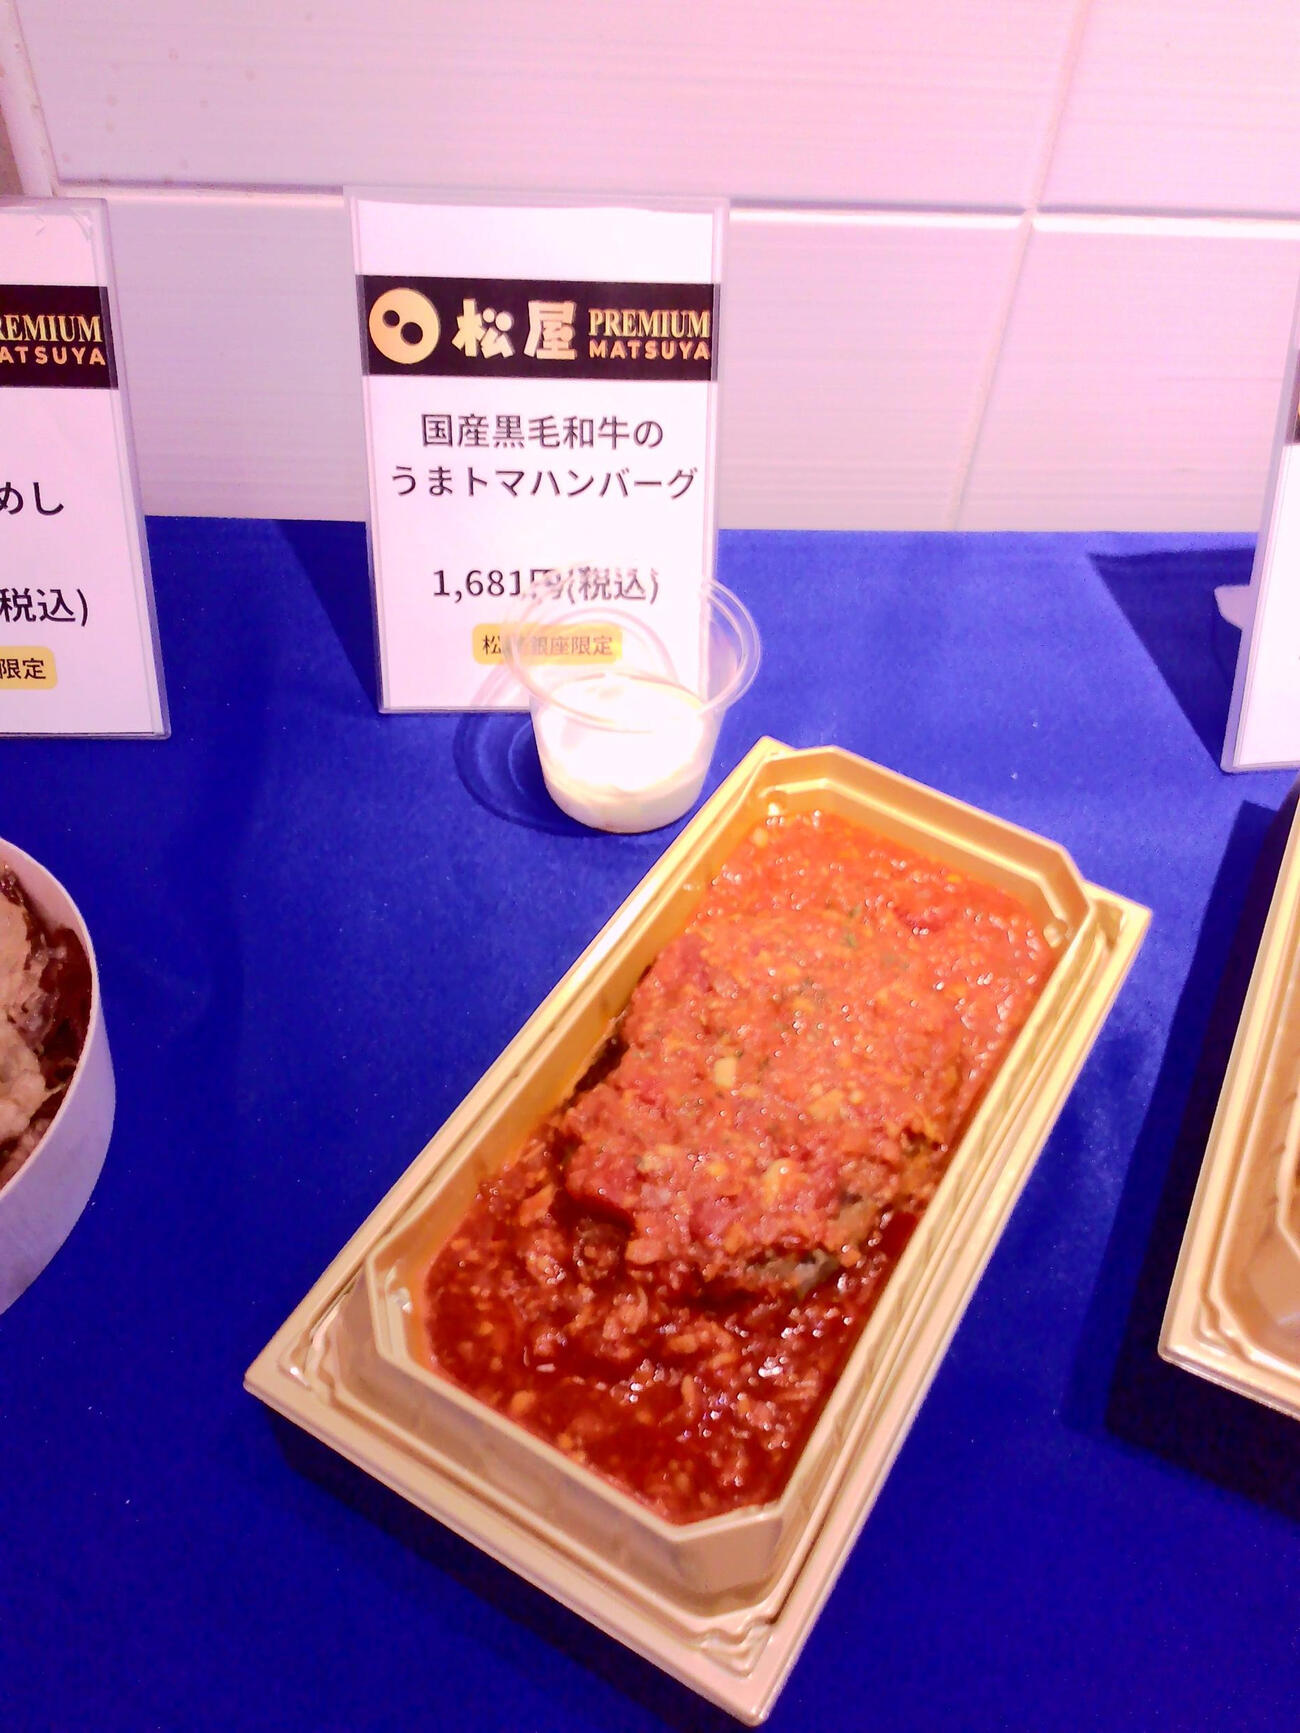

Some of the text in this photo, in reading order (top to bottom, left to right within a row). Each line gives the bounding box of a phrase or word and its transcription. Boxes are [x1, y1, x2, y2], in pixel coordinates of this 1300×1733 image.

[0, 314, 103, 342] EMIUM
[452, 298, 578, 361] 松屋
[588, 308, 711, 339] PREMIUM
[588, 340, 712, 361] MATSUYA
[420, 412, 664, 450] 国産黒毛和牛の
[391, 465, 698, 500] うまトマハンバーグ
[482, 633, 613, 657] 松銀座限定
